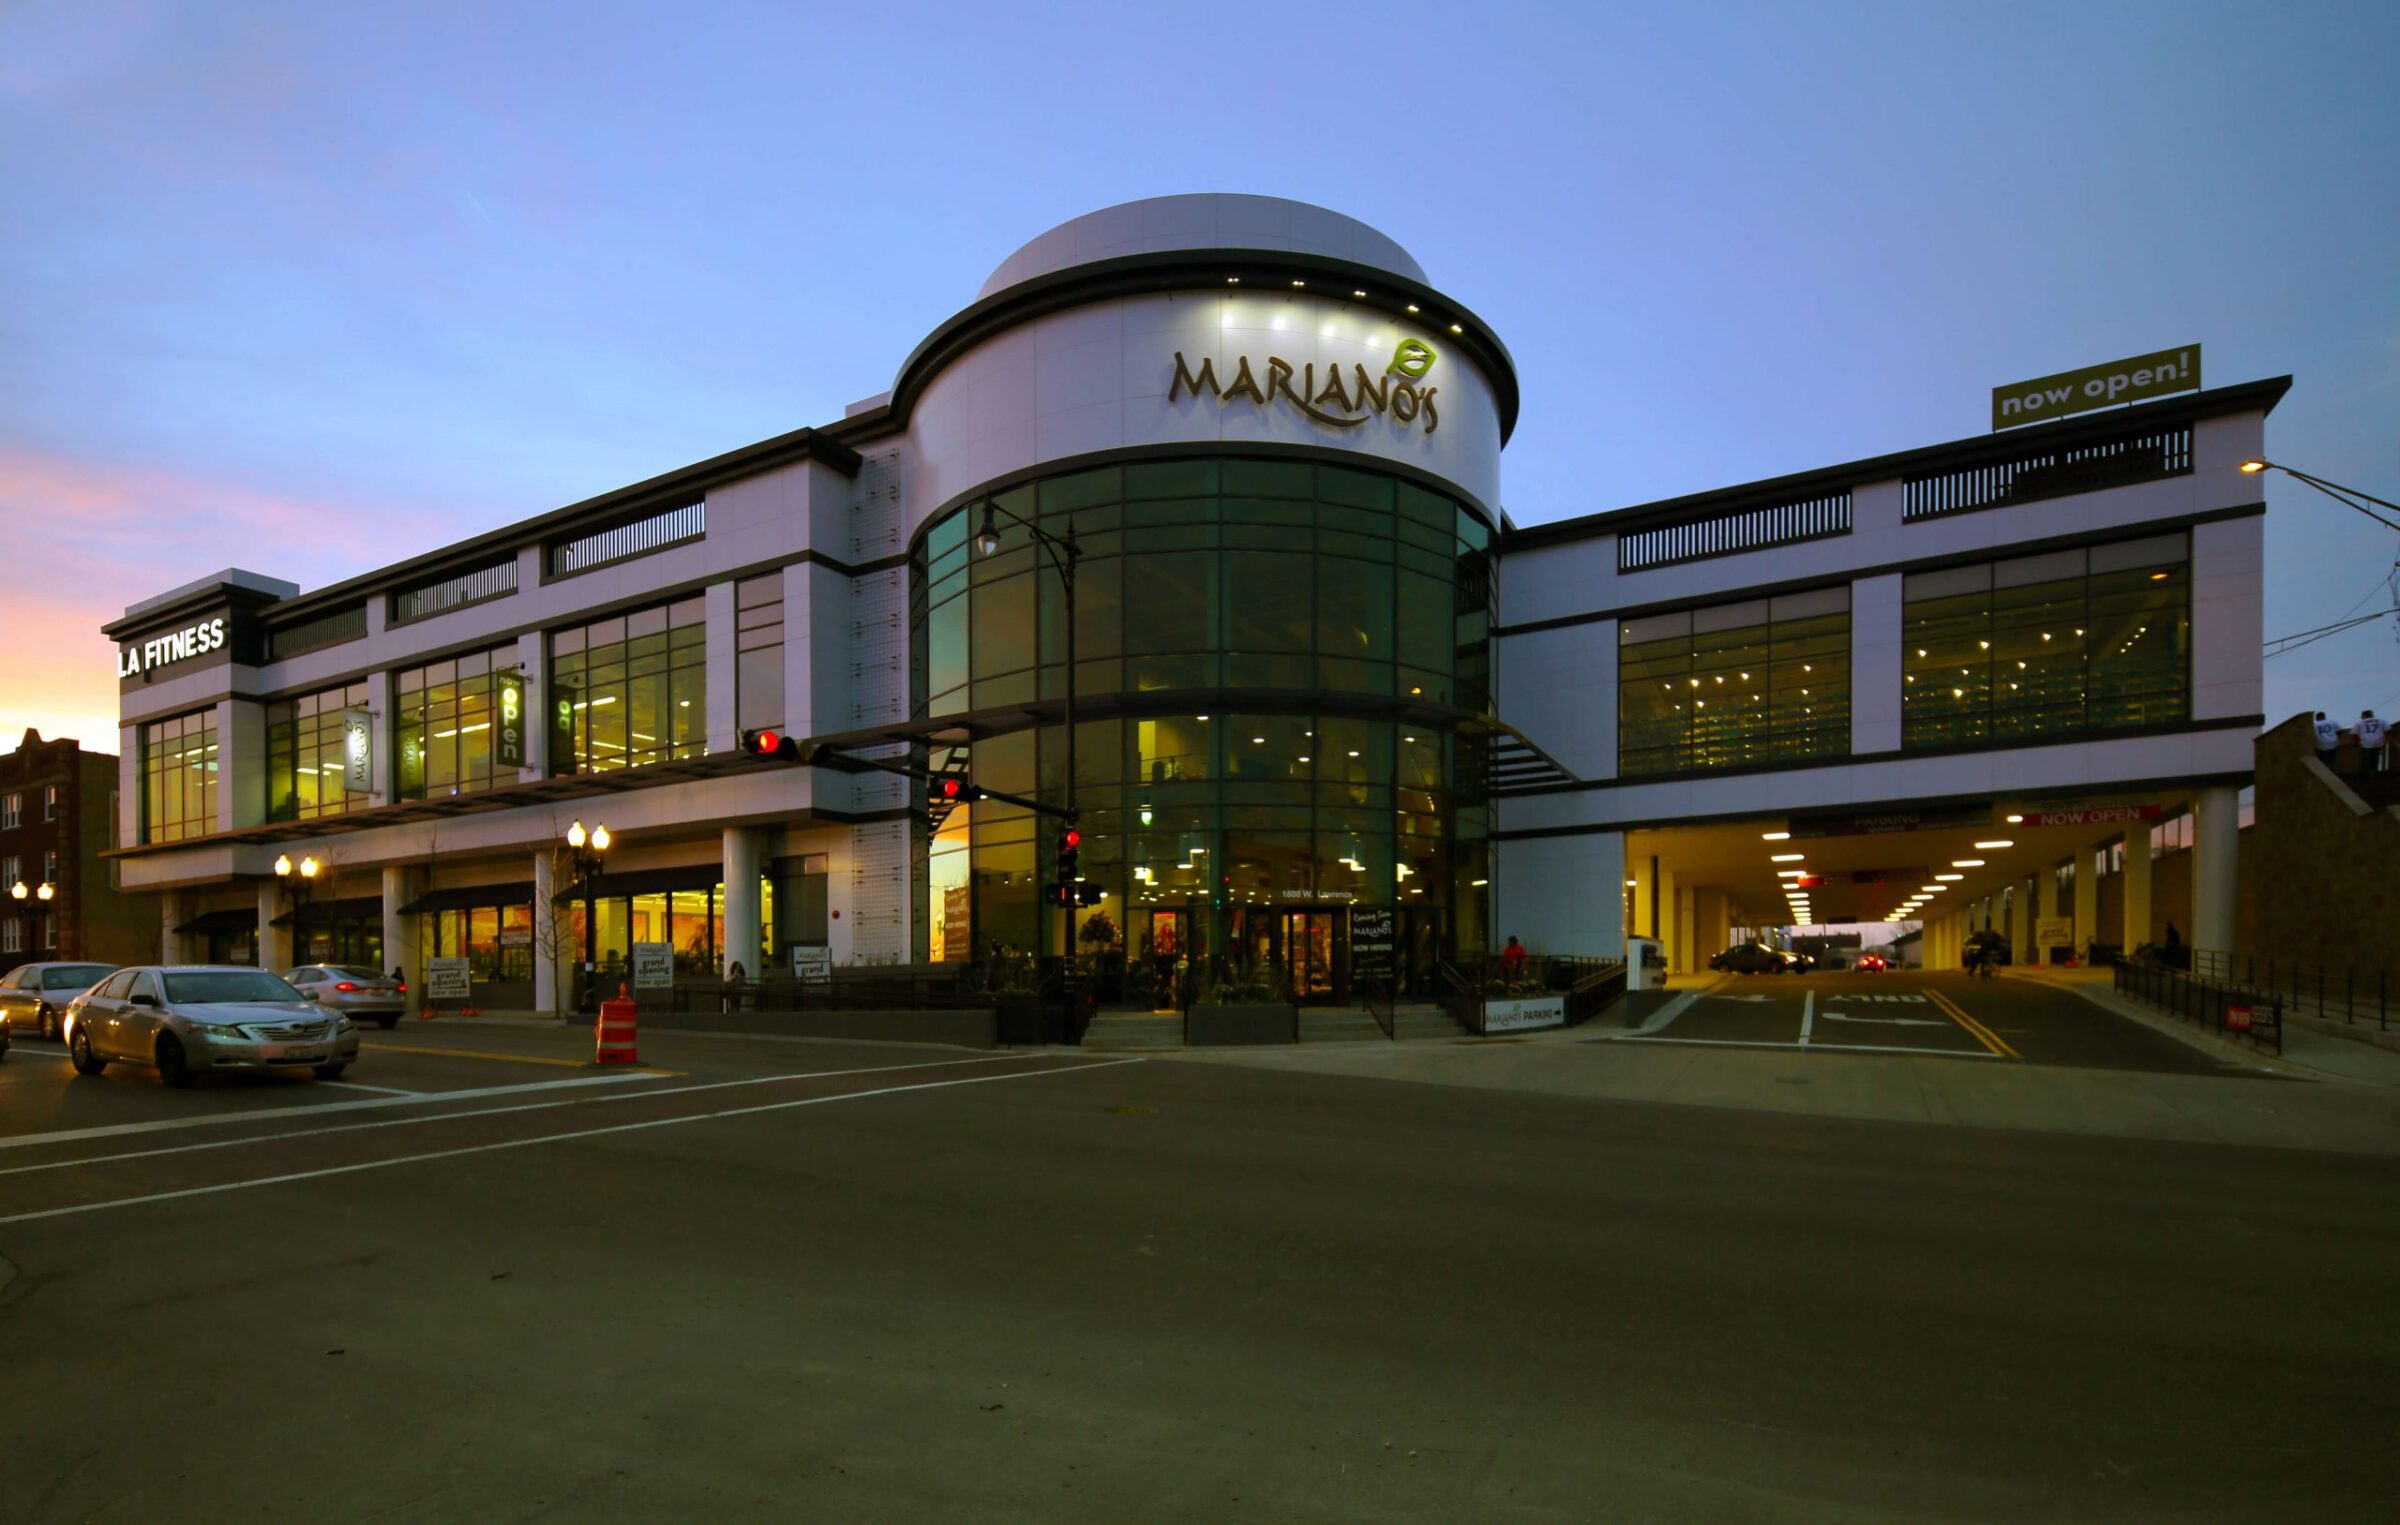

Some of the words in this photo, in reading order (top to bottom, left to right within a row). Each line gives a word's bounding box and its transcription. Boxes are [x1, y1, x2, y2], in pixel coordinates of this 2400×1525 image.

[1169, 352, 1439, 433] MARIANO'S
[2002, 385, 2073, 416] now
[2084, 352, 2189, 400] open!
[118, 648, 140, 678] LA
[144, 618, 224, 670] FITNESS
[500, 676, 520, 687] now
[503, 688, 518, 759] open
[1855, 814, 1920, 828] PARKING
[2041, 811, 2085, 826] NOW
[2089, 807, 2140, 822] OPEN
[1824, 994, 1928, 1003] ONLY
[1523, 1008, 1553, 1022] PARKING
